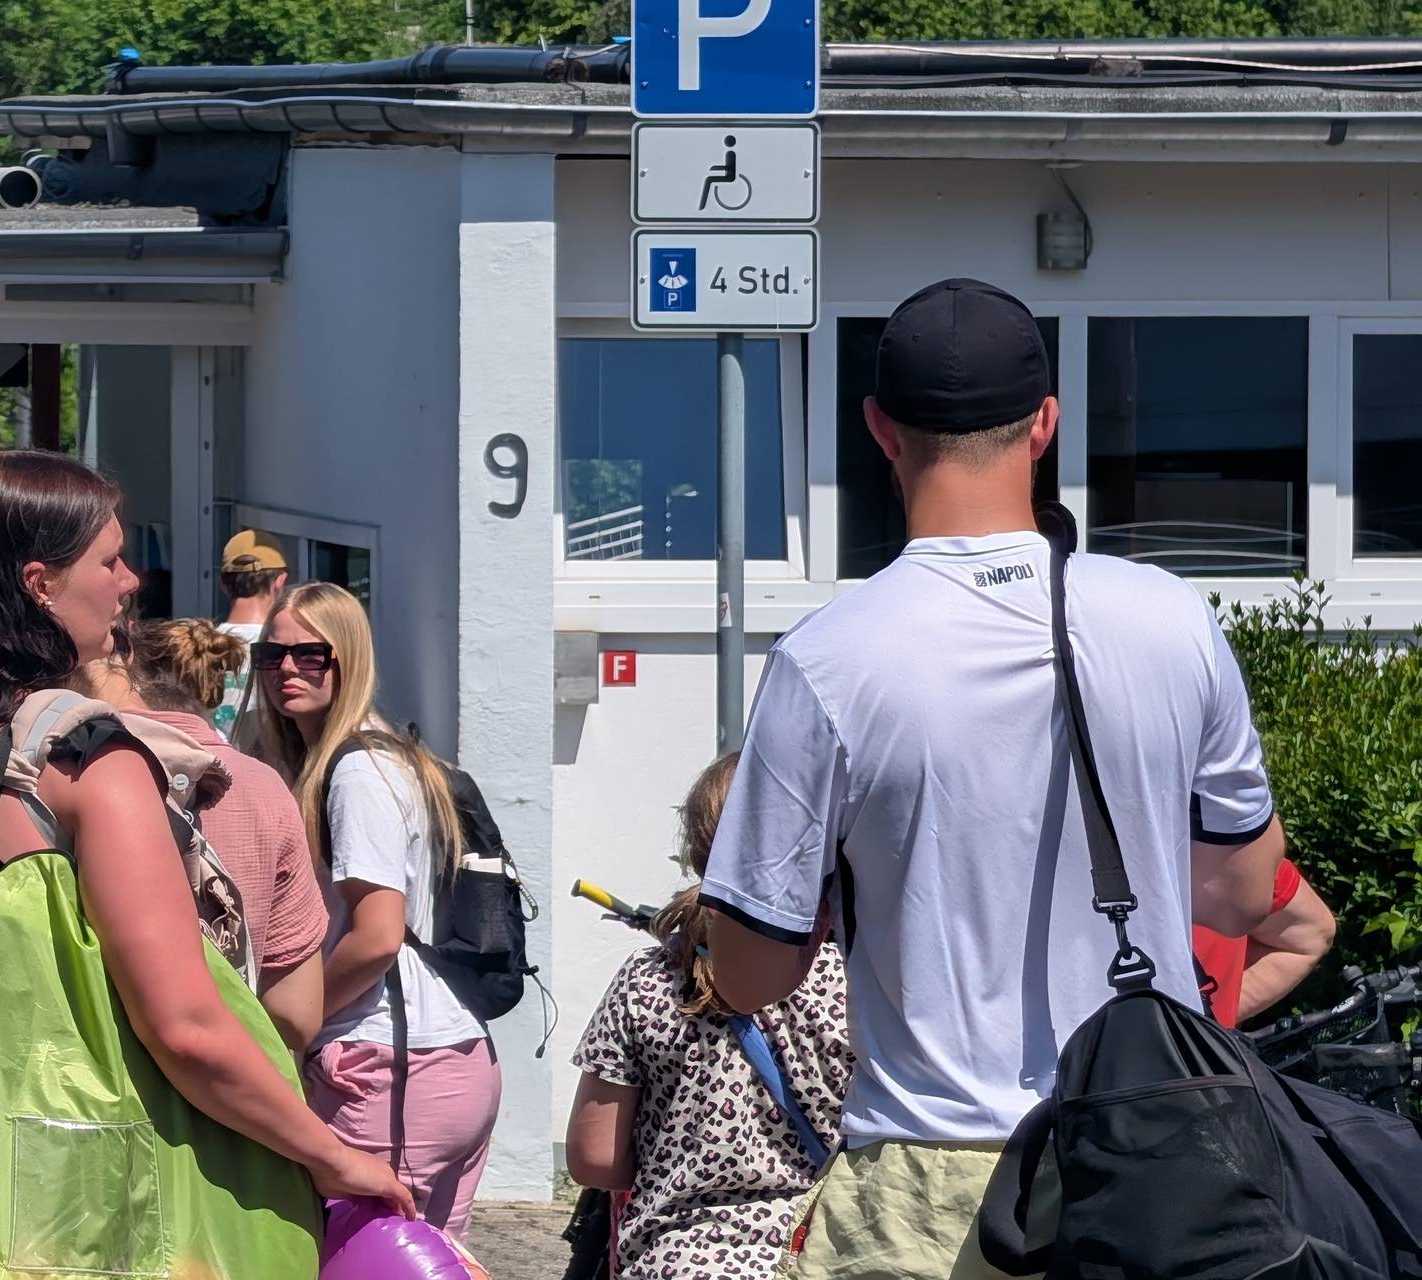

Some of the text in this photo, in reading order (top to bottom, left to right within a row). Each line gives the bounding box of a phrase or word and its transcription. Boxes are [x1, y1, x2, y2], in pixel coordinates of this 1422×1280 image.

[678, 0, 772, 91] P
[709, 265, 799, 296] 4 Std.
[667, 292, 679, 307] P
[483, 432, 529, 519] 9
[986, 563, 1034, 586] NAPOLI
[612, 655, 627, 681] F
